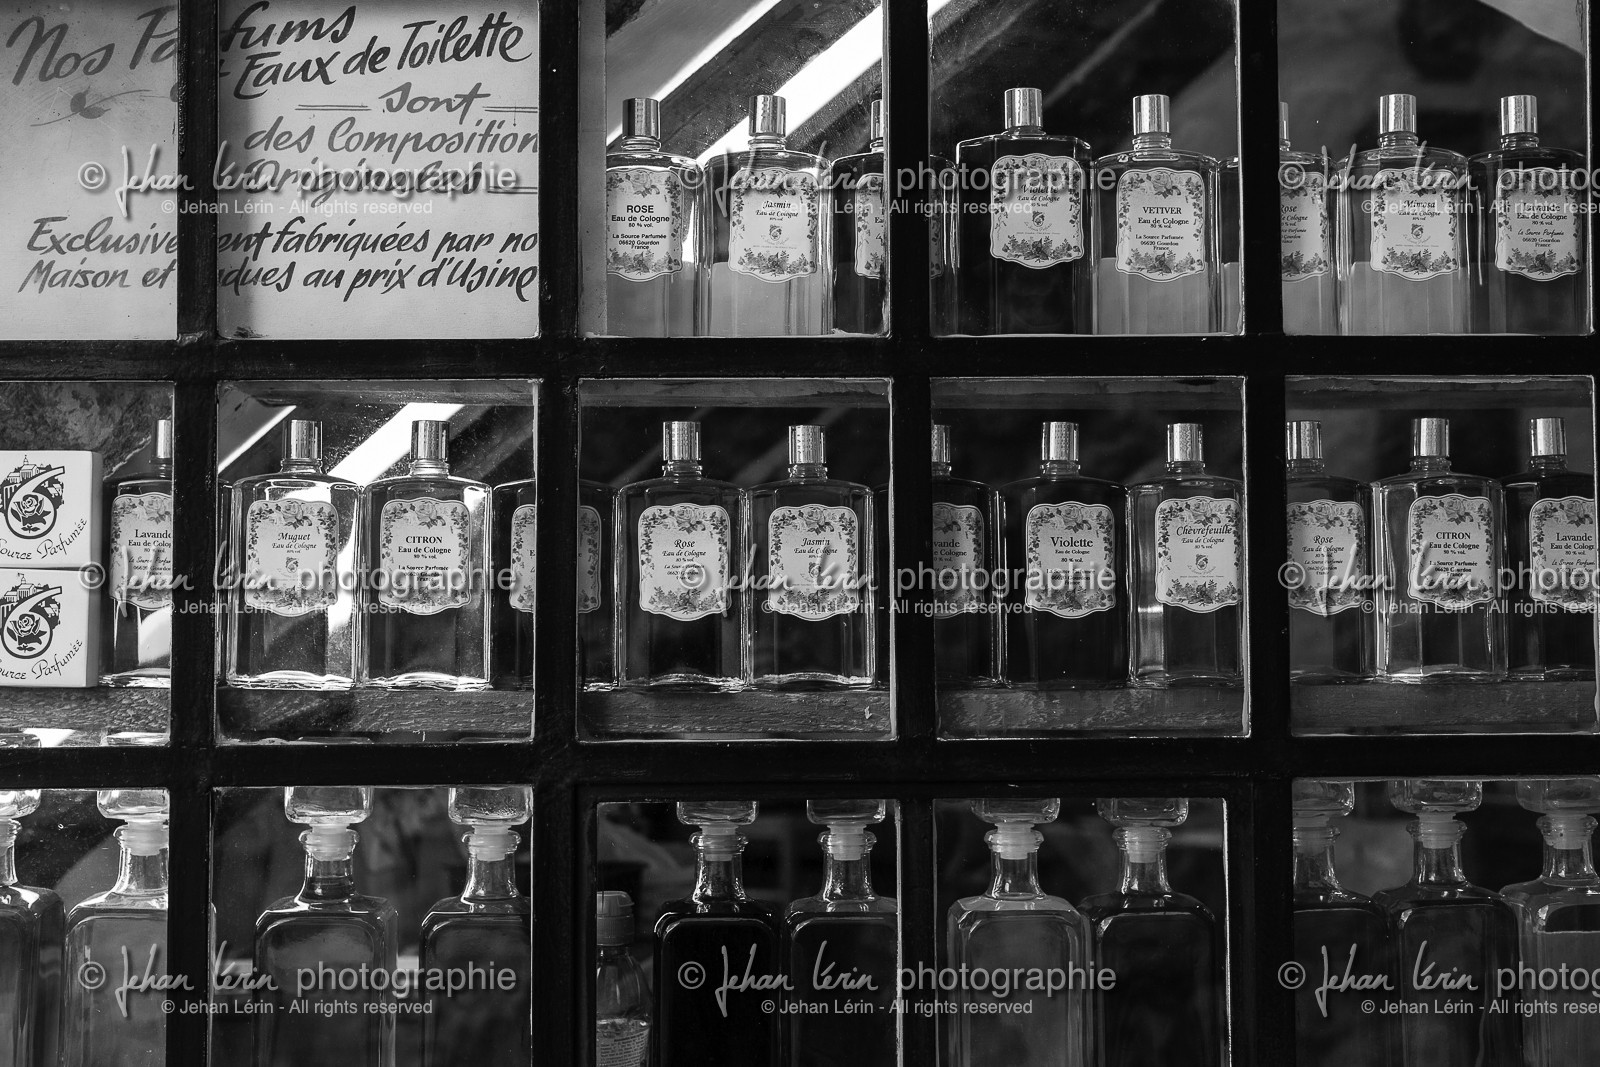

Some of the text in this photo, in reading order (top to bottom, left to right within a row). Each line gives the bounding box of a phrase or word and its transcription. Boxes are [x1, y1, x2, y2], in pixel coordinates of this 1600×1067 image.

[7, 15, 115, 88] Nos
[234, 11, 532, 100] Eaux de Toilette
[243, 115, 317, 155] des
[1038, 195, 1060, 203] Cologne
[627, 205, 654, 213] ROSE
[763, 201, 791, 209] Jasmin
[1143, 206, 1181, 214] VETIVER
[640, 215, 669, 223] Cologne
[438, 228, 496, 267] par
[17, 257, 131, 295] Maison
[142, 258, 177, 292] et
[303, 266, 345, 290] au
[343, 261, 414, 303] prix
[278, 533, 310, 542] Muguet
[1314, 535, 1333, 545] Rose
[1556, 533, 1592, 541] Lavande
[674, 539, 695, 549] Rose
[801, 537, 830, 546] Jasmin
[1050, 537, 1093, 547] Violette
[294, 542, 316, 550] Cologne
[424, 546, 451, 554] Cologne
[1453, 542, 1479, 550] Cologne
[684, 550, 706, 558] Cologne
[816, 547, 837, 555] Cologne
[940, 549, 967, 557] Cologne
[0, 660, 27, 680] ource
